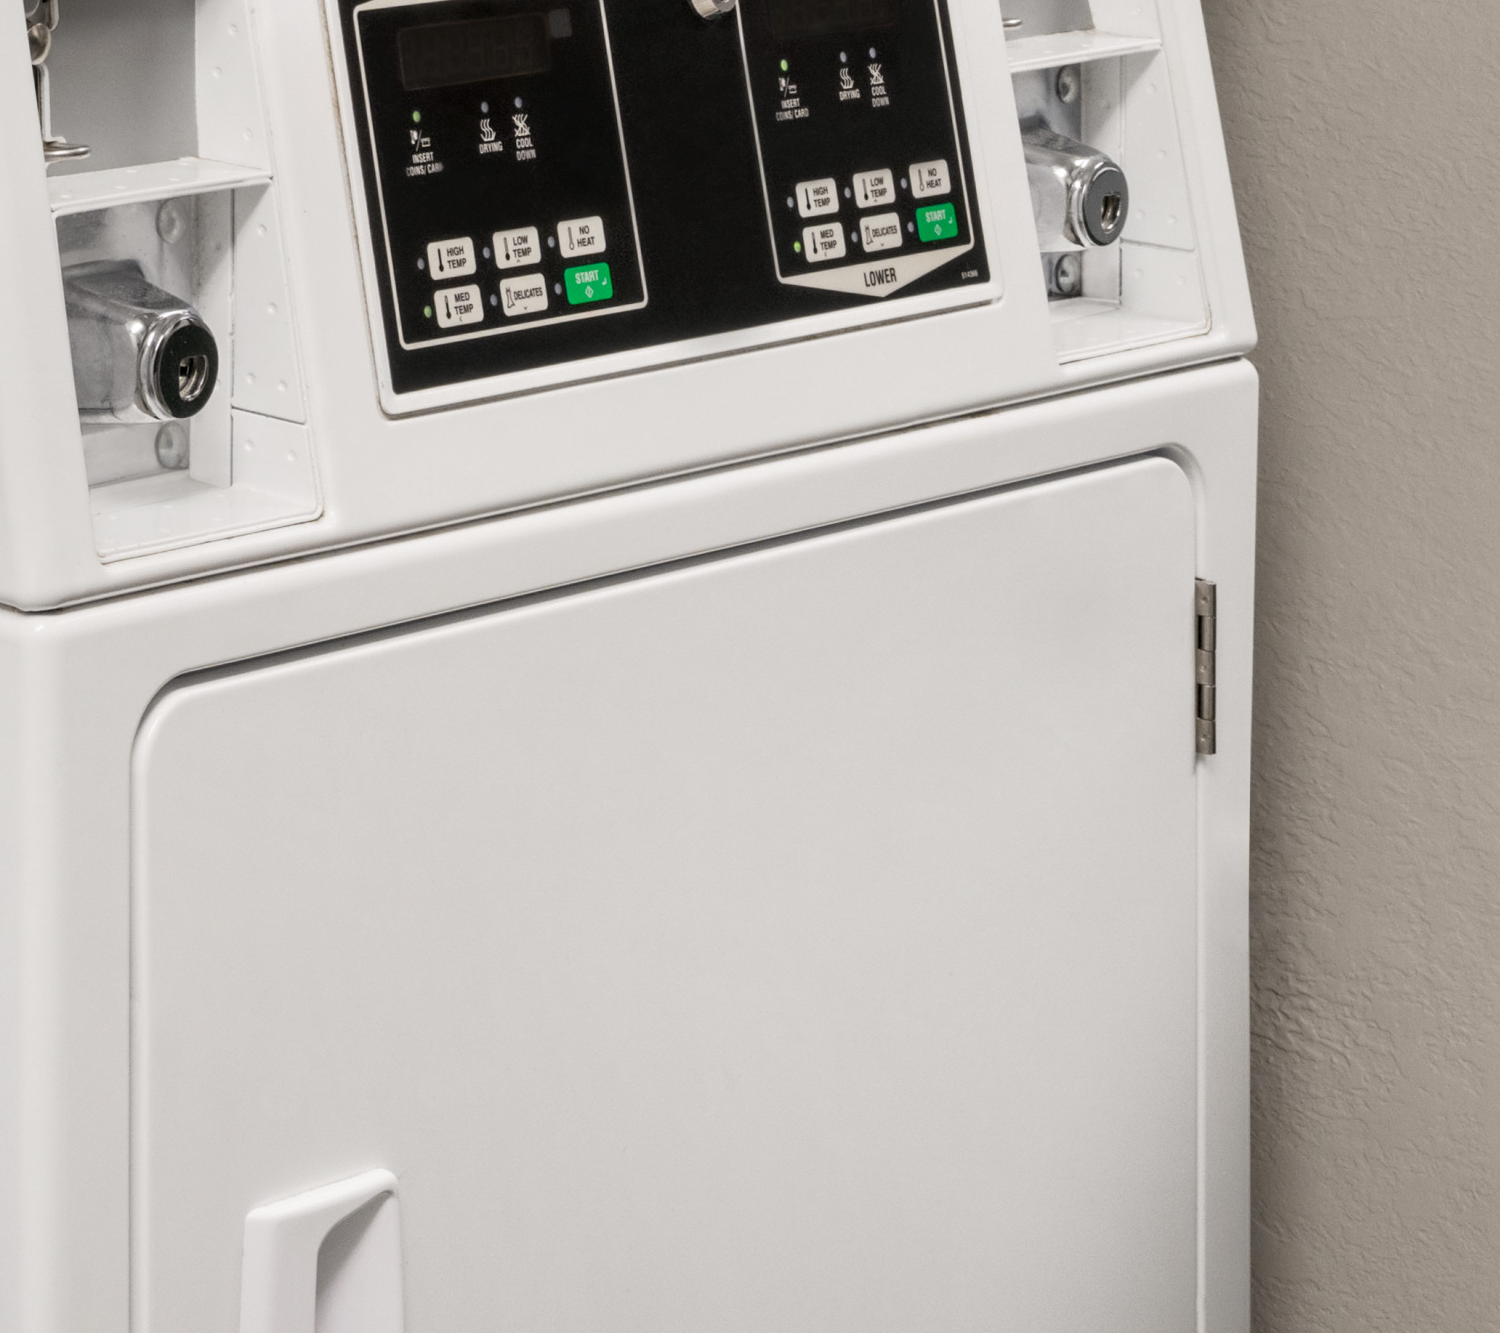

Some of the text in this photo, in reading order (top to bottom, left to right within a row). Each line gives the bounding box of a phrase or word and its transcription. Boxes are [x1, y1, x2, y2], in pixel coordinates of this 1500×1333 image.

[839, 89, 861, 101] DRYING
[871, 85, 887, 96] COOL
[781, 98, 800, 109] INSERT
[871, 96, 890, 108] DOWN
[479, 141, 503, 154] DRYING
[515, 137, 533, 149] COOL
[412, 151, 434, 164] INSERT
[516, 148, 537, 161] DOWN
[928, 168, 937, 177] NO
[870, 177, 884, 186] LOW
[926, 178, 942, 189] HEAT
[813, 186, 828, 196] HIGH
[870, 187, 887, 198] TEMP
[813, 198, 830, 208] TEMP
[925, 209, 946, 223] START
[579, 225, 590, 235] NO
[820, 229, 834, 239] MED
[872, 225, 898, 238] DELICATES
[512, 235, 528, 246] LOW
[577, 236, 596, 247] HEAT
[820, 240, 837, 251] TEMP
[447, 245, 464, 256] HIGH
[512, 247, 532, 258] TEMP
[447, 258, 467, 270] TEMP
[574, 269, 599, 284] START
[863, 267, 897, 287] LOWER
[454, 291, 470, 303] MED
[513, 286, 543, 300] DELICATES
[454, 303, 474, 315] TEMP
